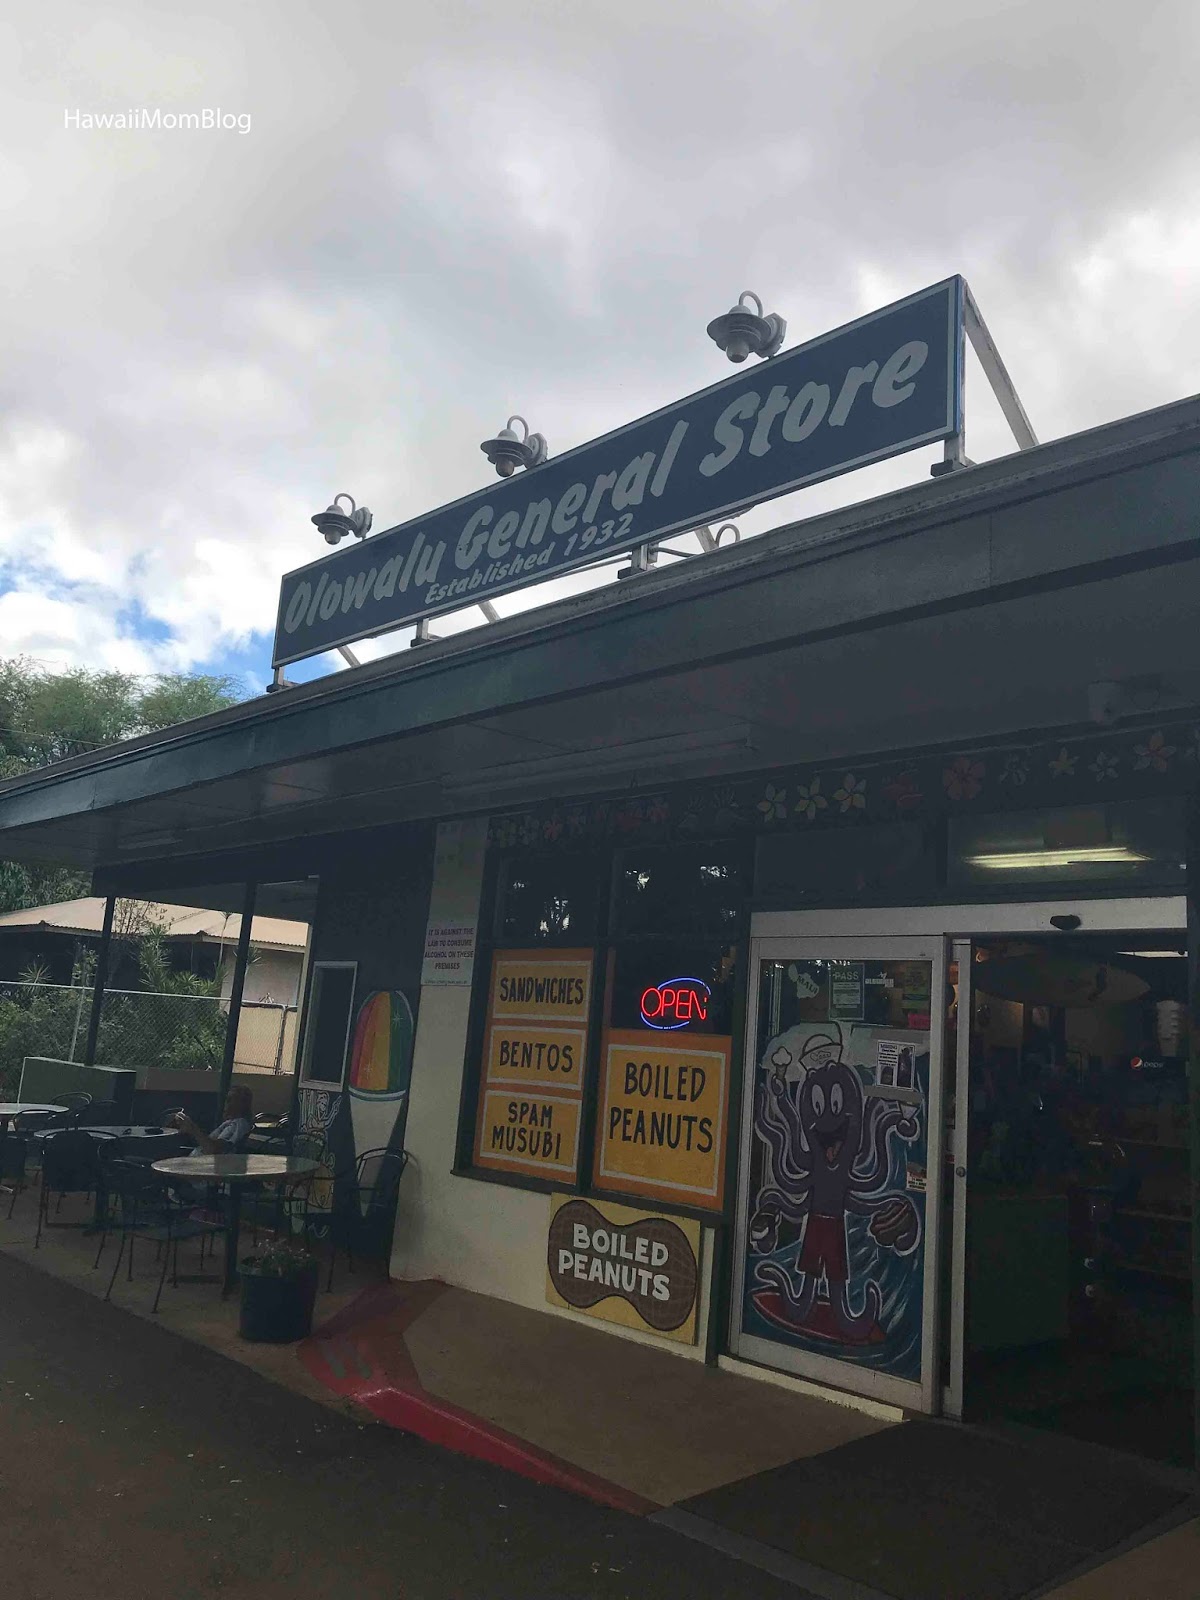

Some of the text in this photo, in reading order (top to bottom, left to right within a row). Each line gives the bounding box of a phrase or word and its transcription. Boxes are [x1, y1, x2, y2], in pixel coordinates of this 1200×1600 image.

[284, 340, 929, 634] Olowalu General Store
[425, 512, 634, 605] Established 1932
[434, 928, 439, 936] IS
[440, 928, 462, 936] AGAINST
[463, 927, 474, 935] THE
[447, 939, 472, 947] CONSUME
[434, 962, 460, 970] PREMISES
[456, 950, 474, 958] THESE
[499, 976, 584, 1005] SANDWICHES
[834, 971, 859, 981] PASS
[641, 986, 707, 1020] OPEN
[499, 1040, 573, 1073] BENTOS
[624, 1062, 706, 1103] BOILED
[508, 1101, 553, 1129] SPAM
[609, 1106, 713, 1154] PEANUTS
[491, 1125, 561, 1160] MUSUBI
[573, 1222, 669, 1267] BOILED
[558, 1249, 670, 1301] PEANUTS
